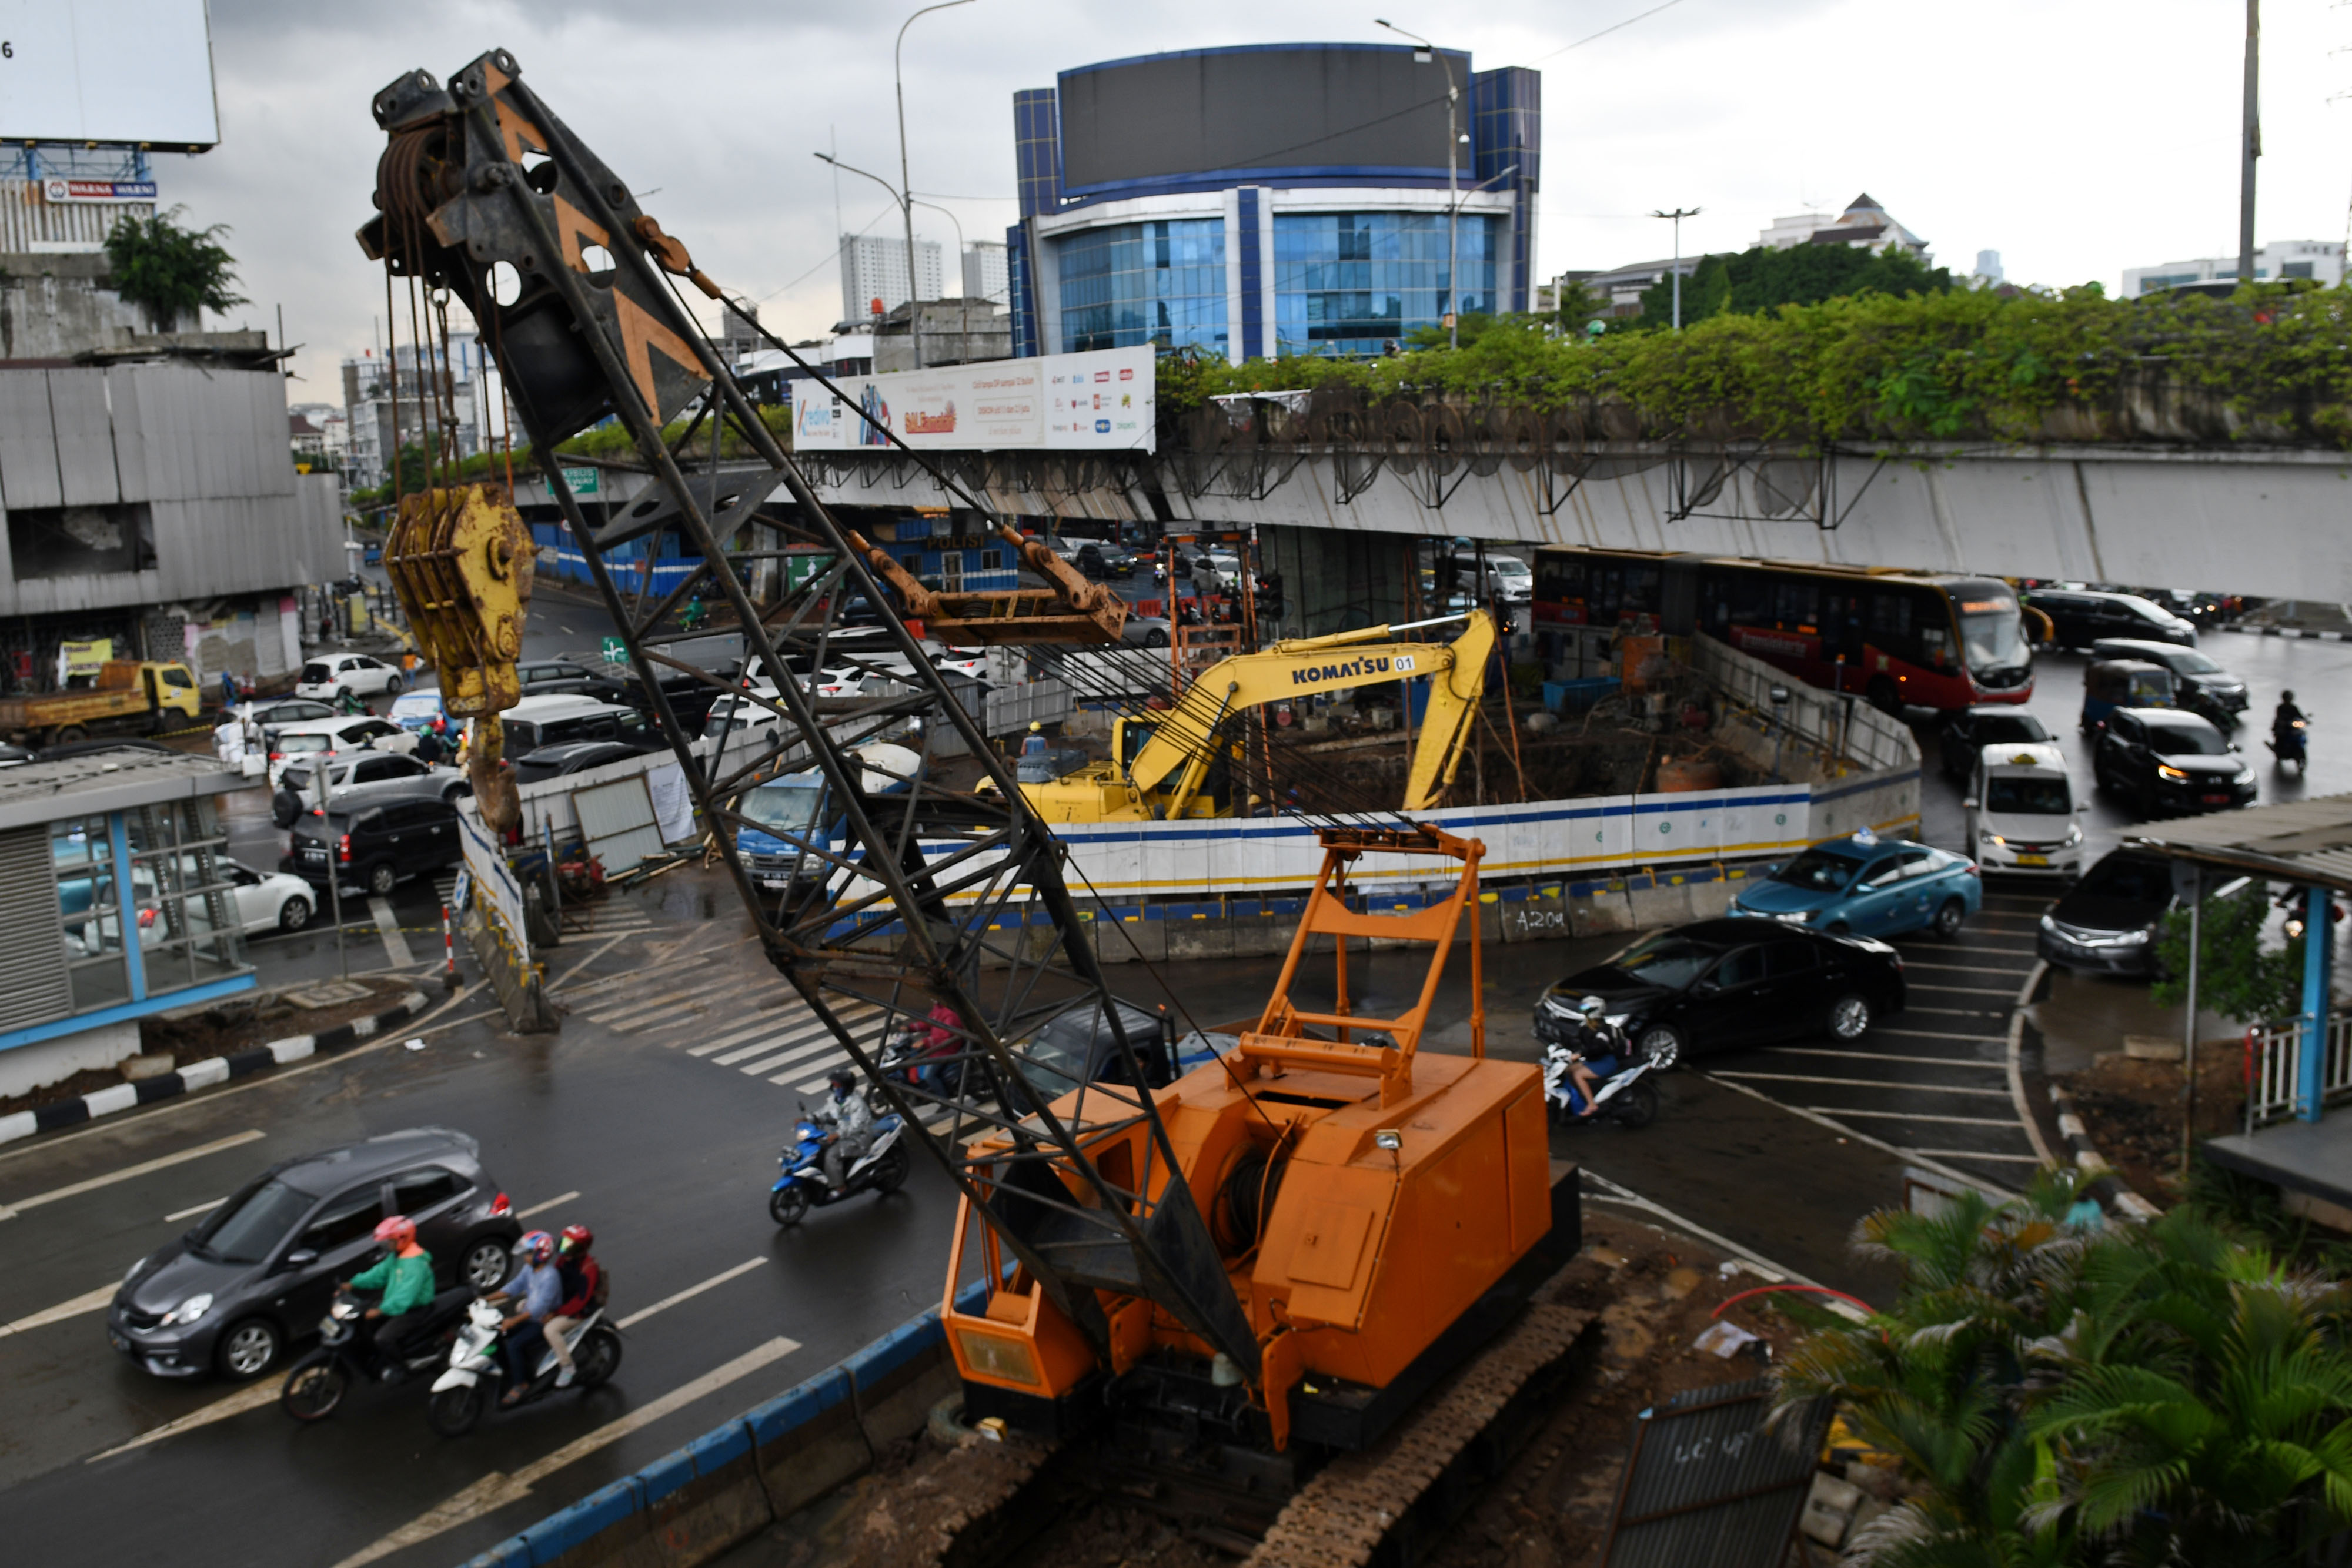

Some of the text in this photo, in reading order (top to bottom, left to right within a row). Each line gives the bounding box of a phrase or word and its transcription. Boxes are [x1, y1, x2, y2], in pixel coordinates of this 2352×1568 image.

[69, 183, 154, 194] WARNA WARNI
[927, 533, 984, 550] POLISI
[1292, 656, 1413, 684] KOMATSU 01
